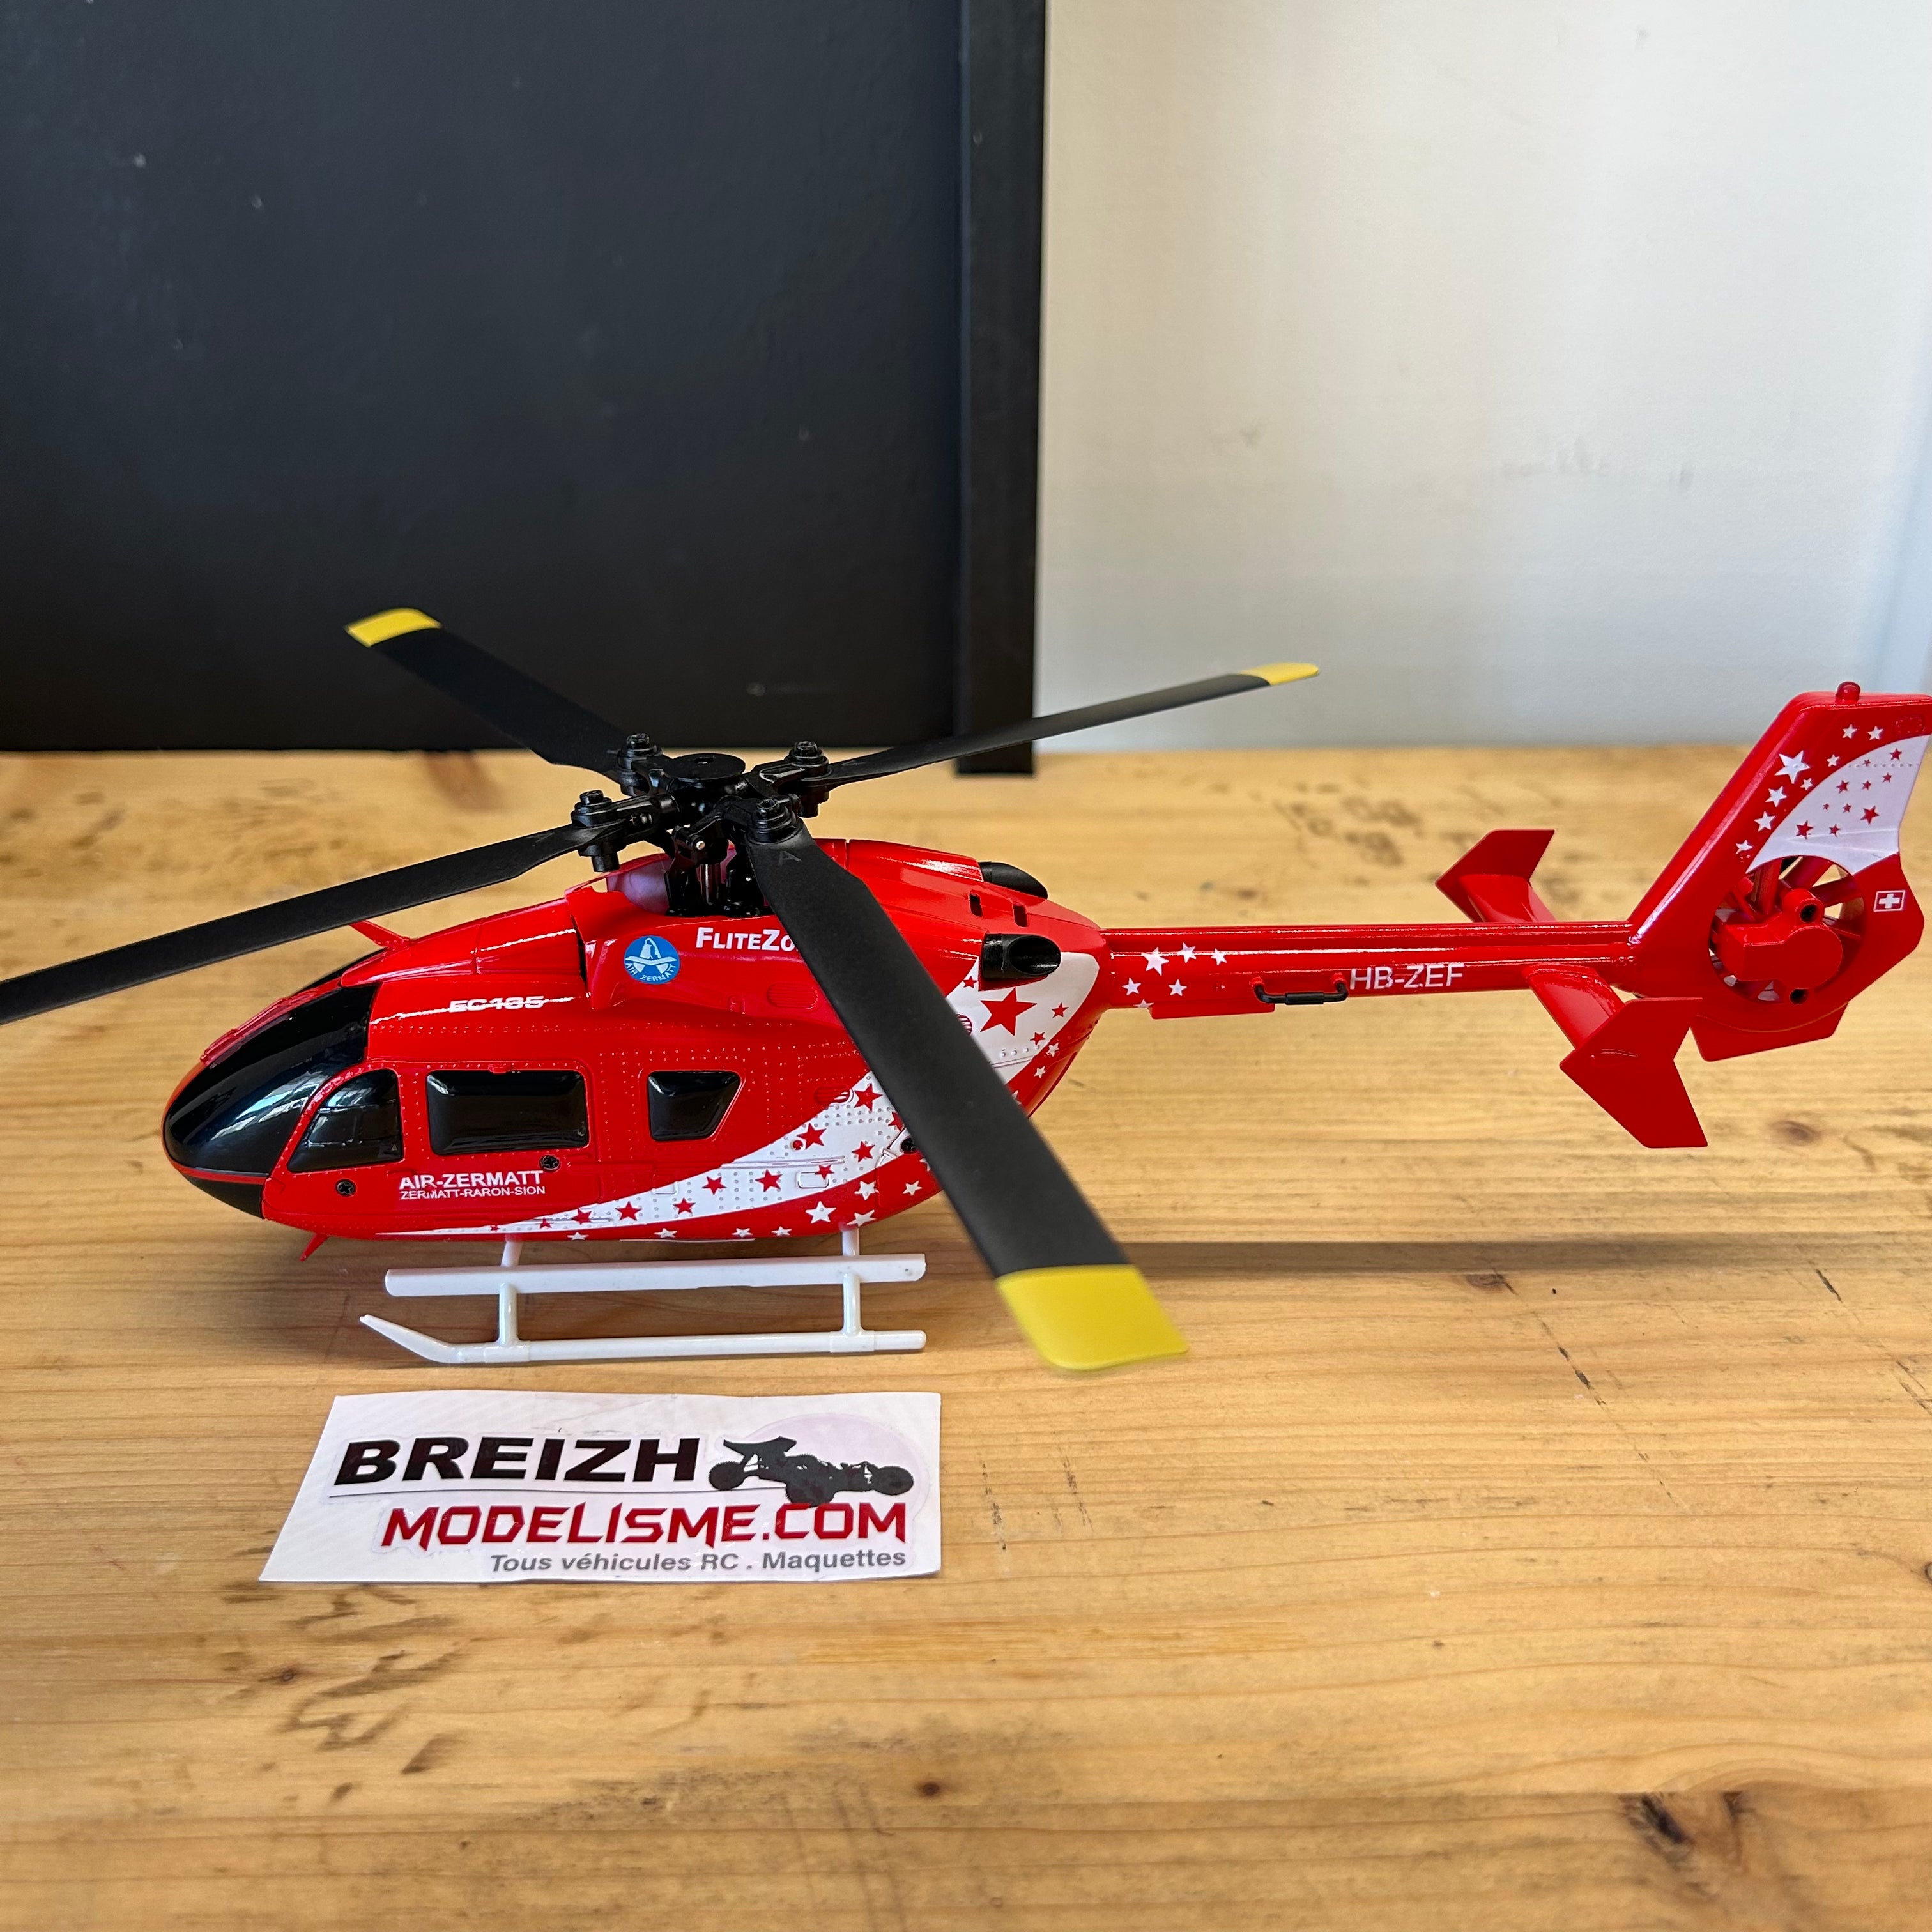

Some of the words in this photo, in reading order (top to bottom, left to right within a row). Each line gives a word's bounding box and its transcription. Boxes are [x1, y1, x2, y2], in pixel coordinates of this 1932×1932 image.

[696, 926, 799, 952] FLITEZO
[625, 963, 638, 976] AIR
[640, 963, 676, 982] ZERMATT
[1349, 963, 1464, 990] HB-ZEF
[448, 995, 544, 1013] EC135
[399, 1170, 544, 1190] AIR-ZERMATT
[399, 1185, 546, 1200] ZERMATT-RARON-SION
[334, 1436, 700, 1486] BREIZH
[381, 1501, 907, 1551] MODELISME.COM
[491, 1554, 553, 1572] Tous
[562, 1552, 692, 1571] véhicules
[701, 1552, 739, 1570] RC
[762, 1549, 907, 1573] Maquettes
